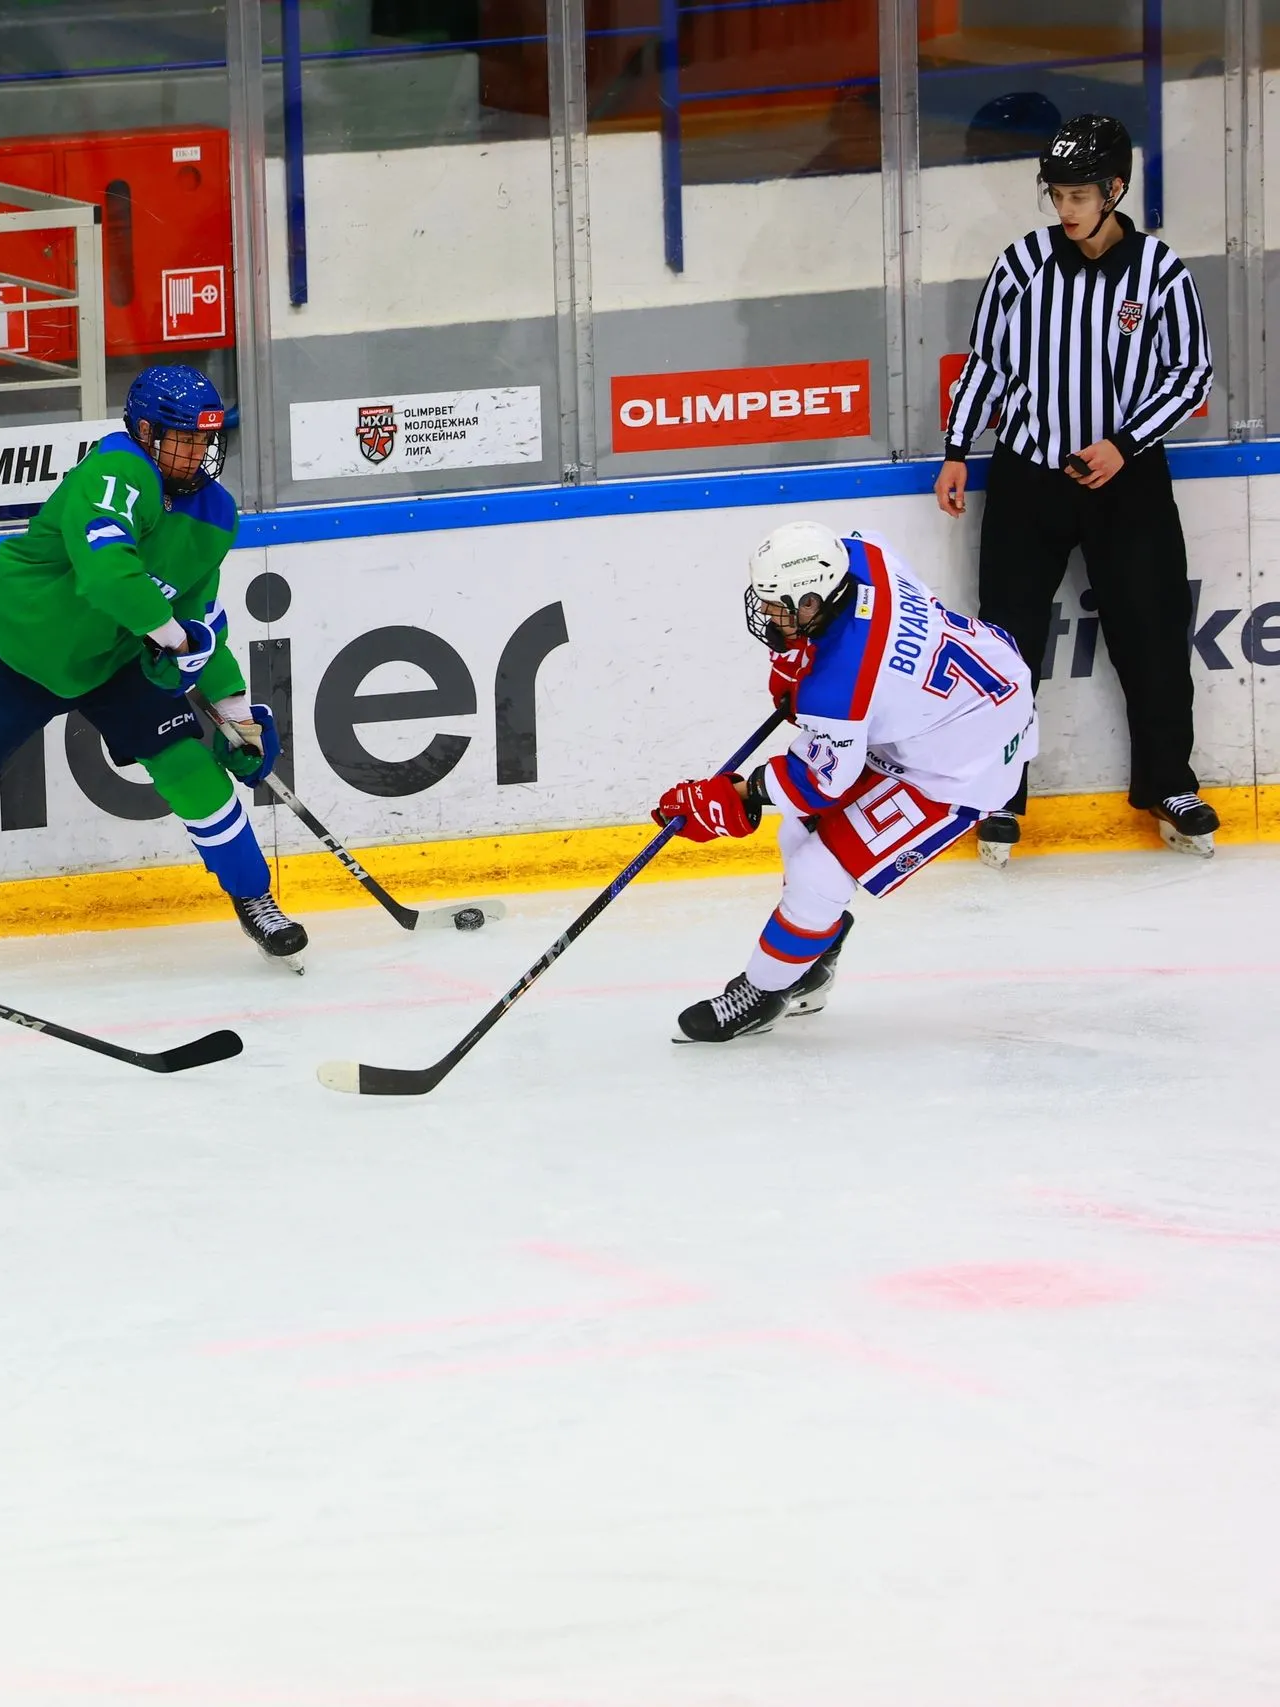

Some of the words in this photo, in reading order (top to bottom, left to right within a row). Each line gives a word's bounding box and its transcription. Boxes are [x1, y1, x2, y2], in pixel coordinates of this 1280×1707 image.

[1052, 140, 1077, 158] 67
[403, 405, 455, 418] OLIMPBET
[620, 384, 861, 428] OLIMPBET
[360, 414, 392, 427] МХЛ
[404, 416, 479, 430] МОЛОДЕЖНАЯ
[404, 430, 467, 443] ХОККЕЙНАЯ
[405, 446, 432, 456] ЛИГА
[93, 475, 140, 527] 11
[157, 712, 196, 736] CCM
[320, 834, 369, 881] CCM
